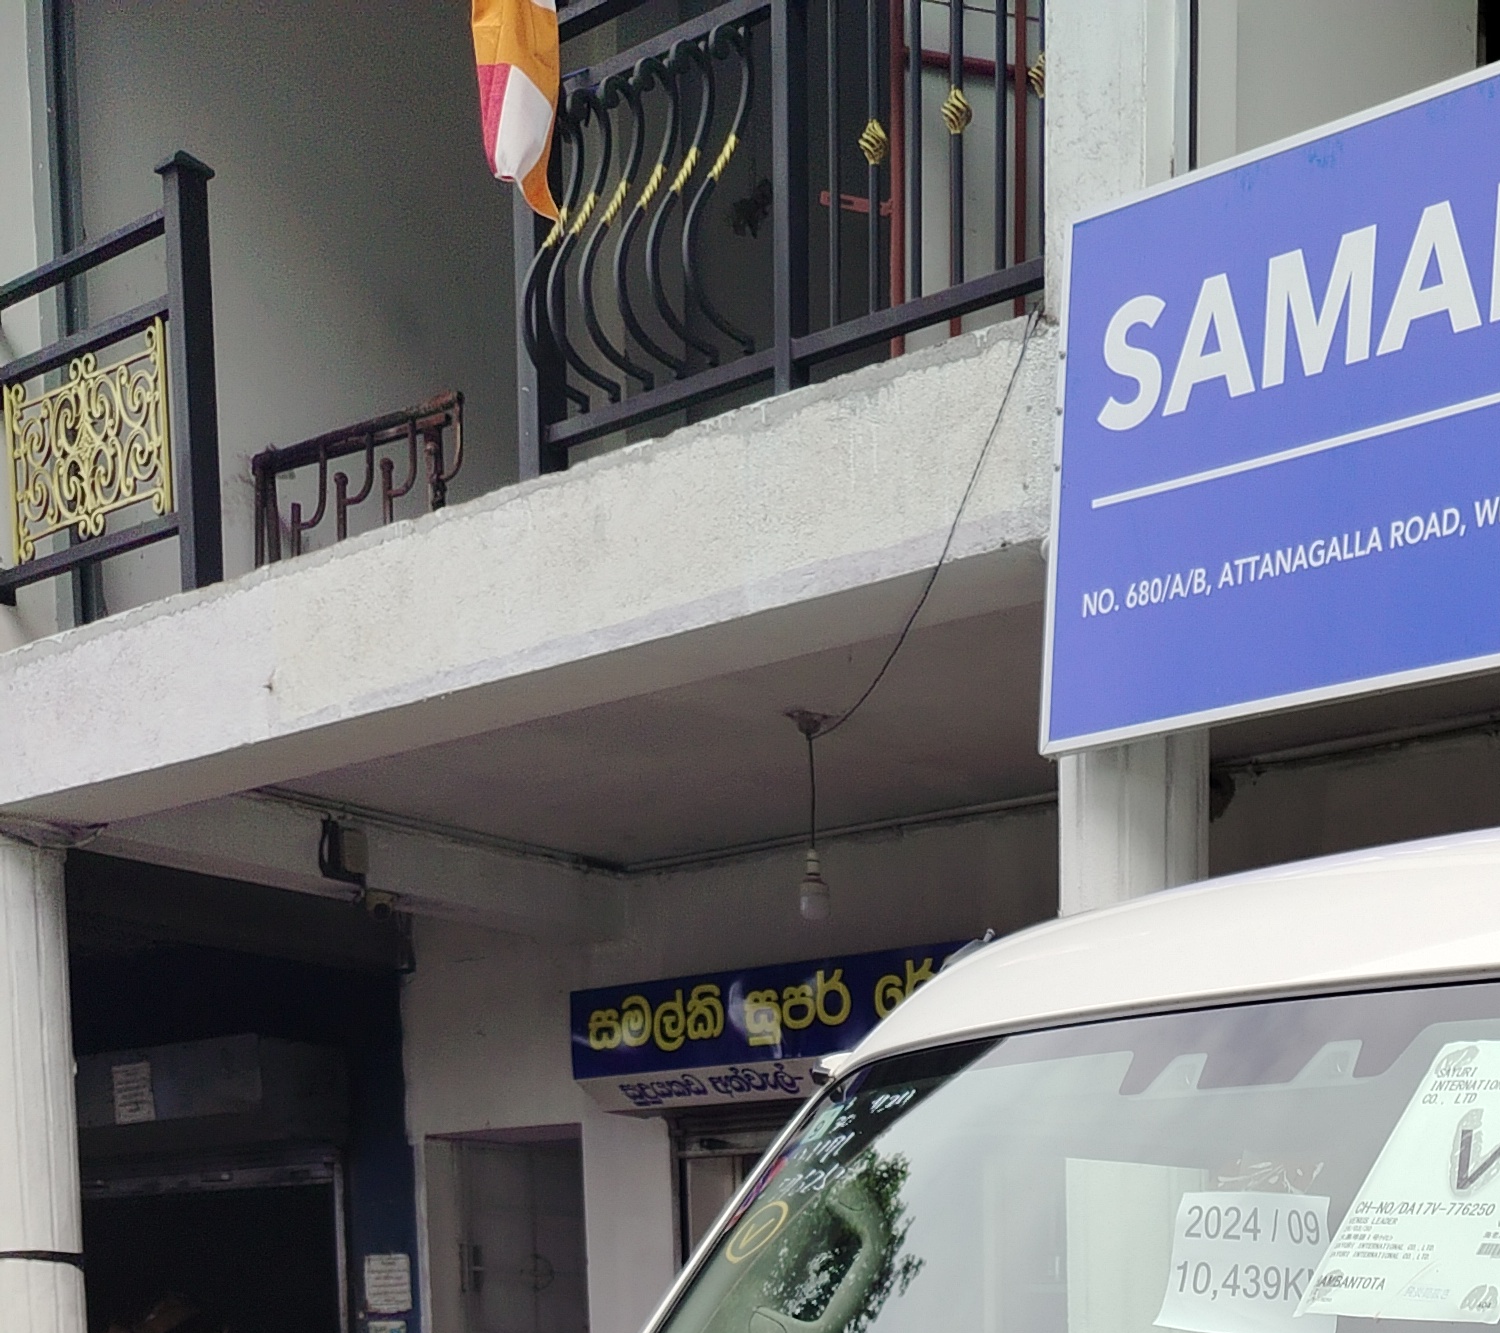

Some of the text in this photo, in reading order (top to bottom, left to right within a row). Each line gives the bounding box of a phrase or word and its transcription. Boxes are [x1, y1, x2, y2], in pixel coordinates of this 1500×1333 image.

[1081, 590, 1120, 618] NO.
[1126, 566, 1213, 609] 680/A/B,
[1217, 522, 1383, 591] ATTANAGALLA
[1388, 508, 1468, 549] ROAD,
[1436, 1066, 1479, 1079] SAYURI
[1454, 1093, 1478, 1105] LTD
[1354, 1201, 1496, 1217] CH-NO/DA17V-776250
[1184, 1205, 1261, 1242] 2024
[1287, 1209, 1320, 1245] 09
[1371, 1217, 1399, 1226] LEADER
